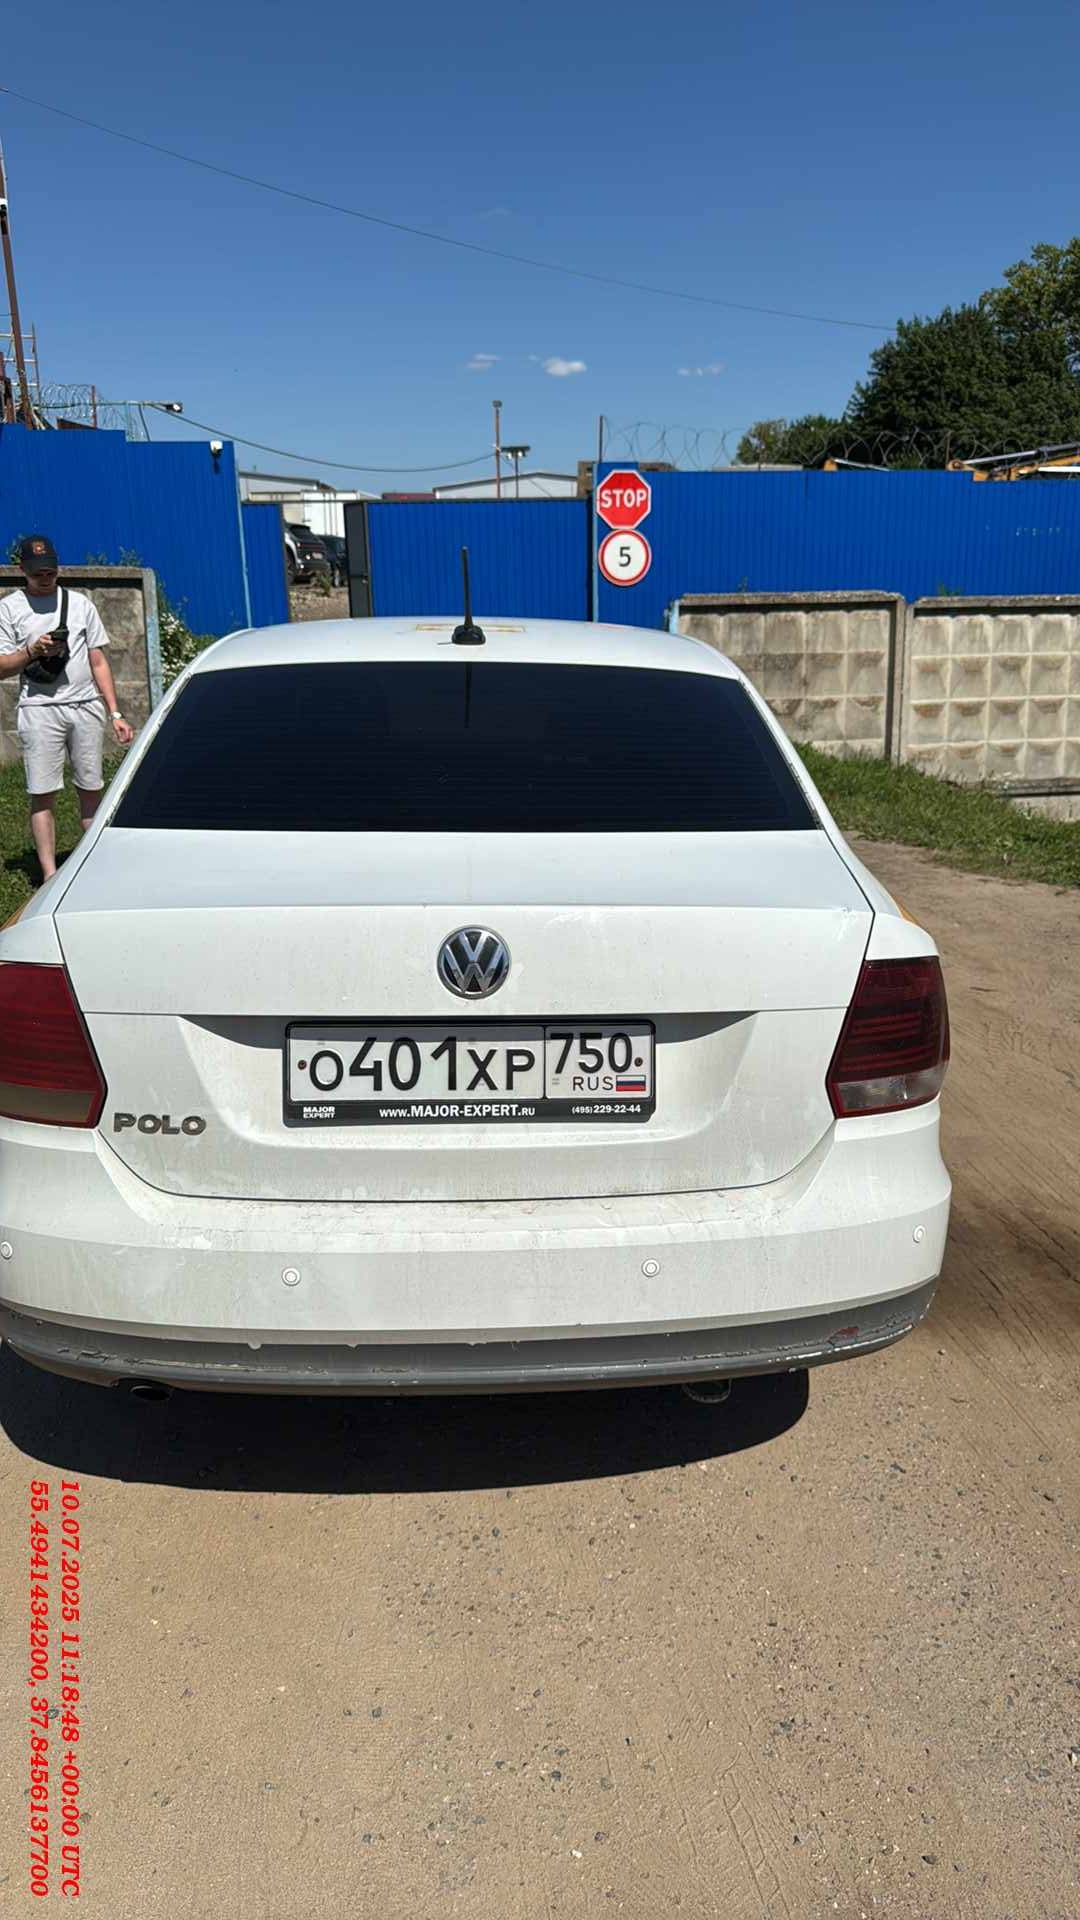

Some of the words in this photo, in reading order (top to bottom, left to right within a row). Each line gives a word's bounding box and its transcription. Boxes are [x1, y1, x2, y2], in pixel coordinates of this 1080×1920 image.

[601, 488, 647, 508] STOP
[619, 546, 631, 567] 5
[553, 1032, 632, 1074] 750
[572, 1076, 613, 1091] RUS
[113, 1112, 207, 1135] POLO
